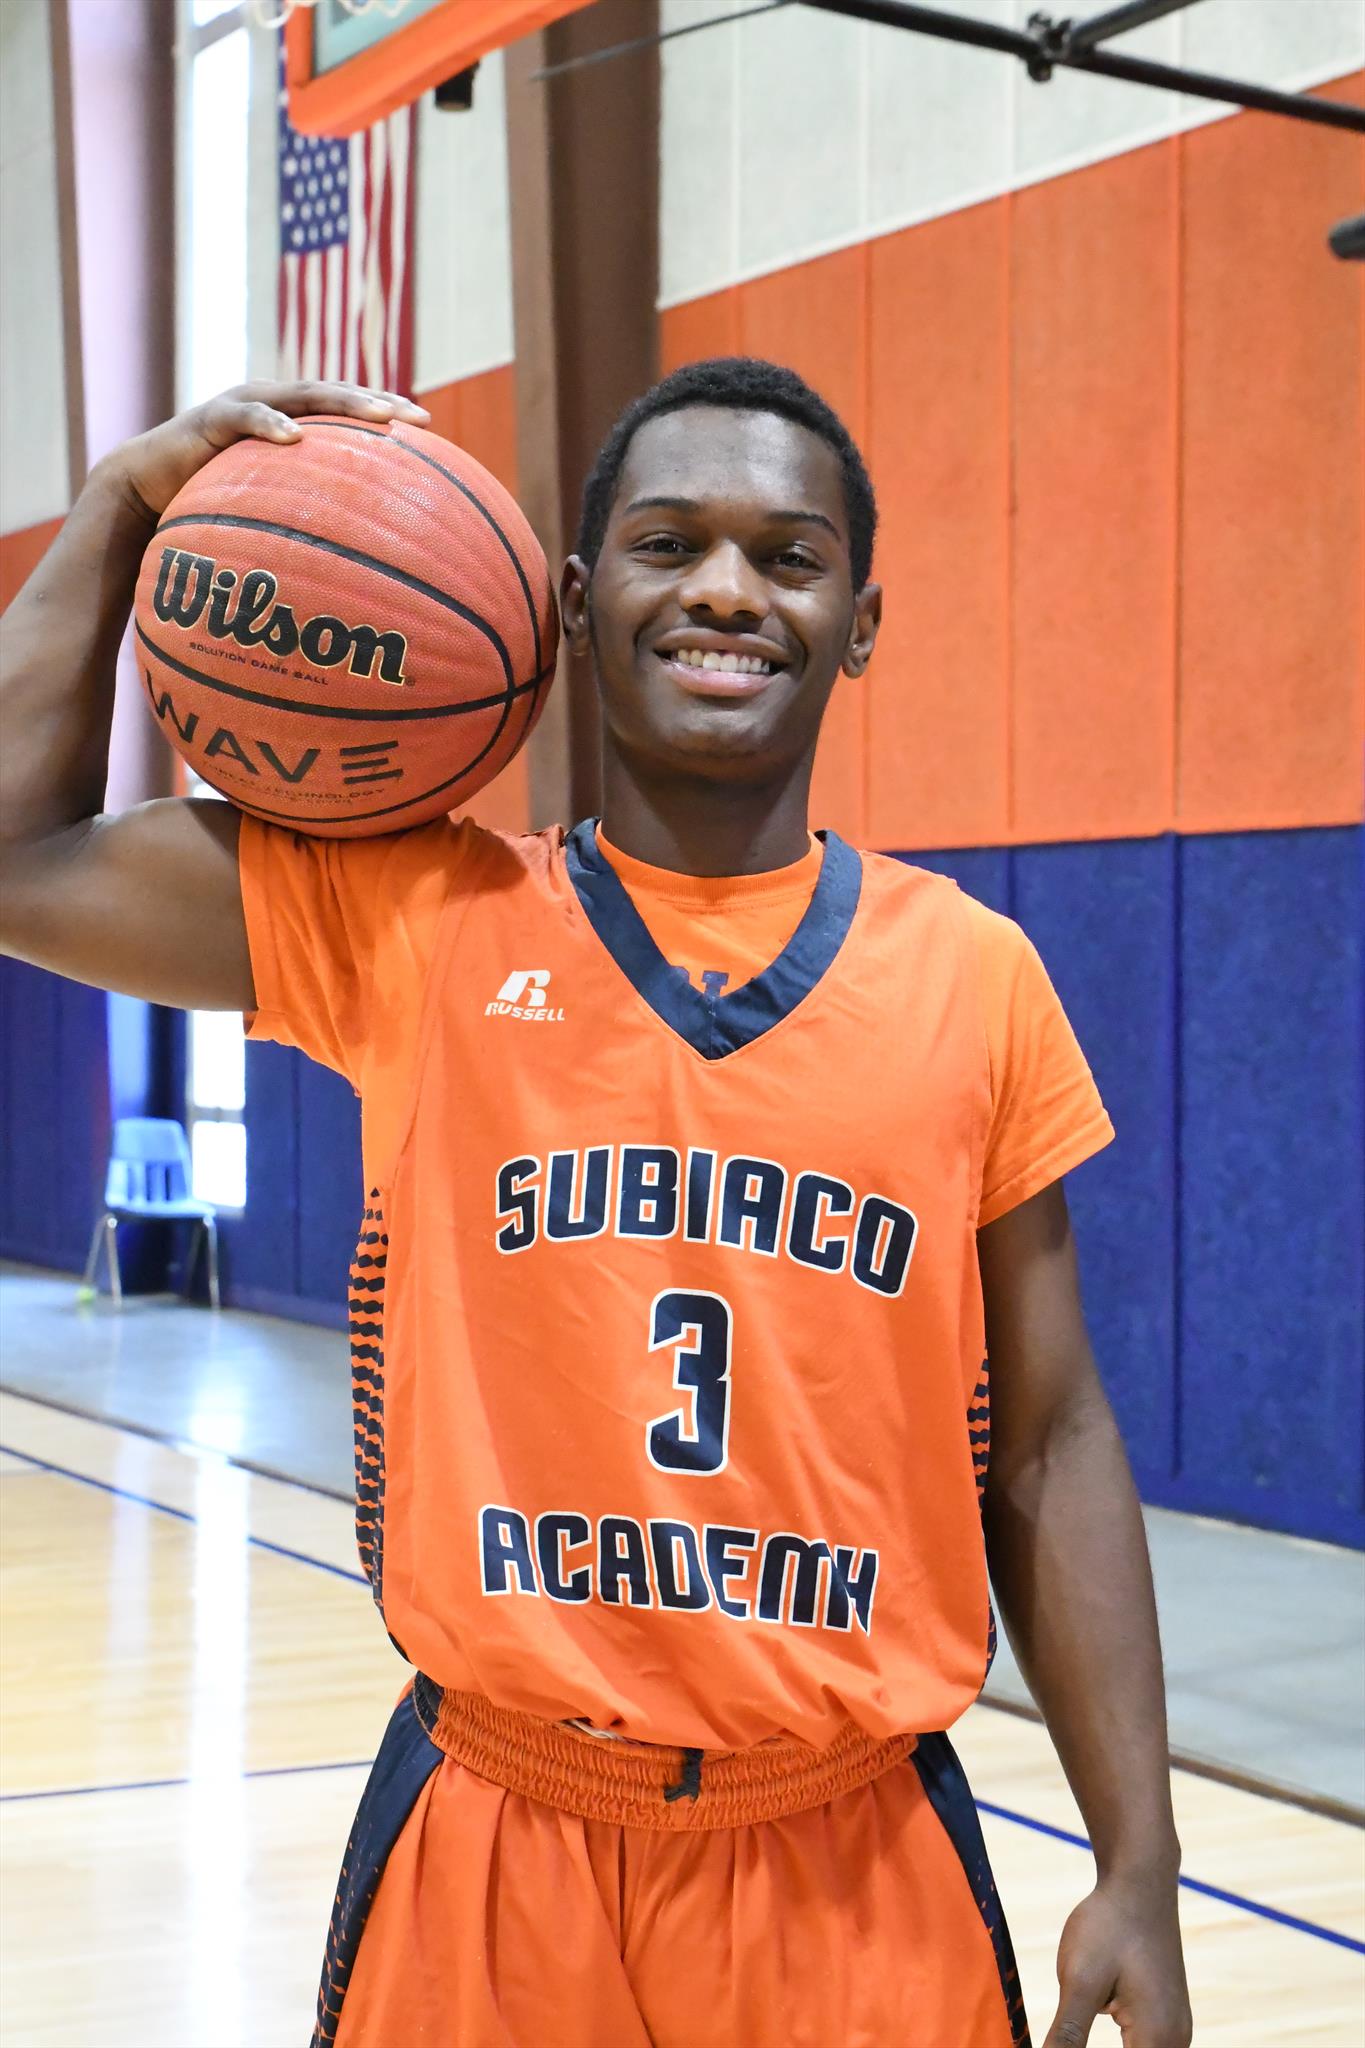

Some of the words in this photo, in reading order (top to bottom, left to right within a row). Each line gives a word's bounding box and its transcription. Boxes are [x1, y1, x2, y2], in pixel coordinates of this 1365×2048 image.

[153, 546, 408, 686] Wilson
[189, 641, 246, 664] SOLUTION
[251, 659, 288, 676] GAME
[293, 671, 329, 686] BALL
[145, 668, 404, 784] WAVE
[484, 1002, 565, 1022] RUSSELL
[495, 1143, 919, 1299] SUBIACO
[645, 1287, 733, 1477] 3
[478, 1503, 879, 1638] ACADEMY
